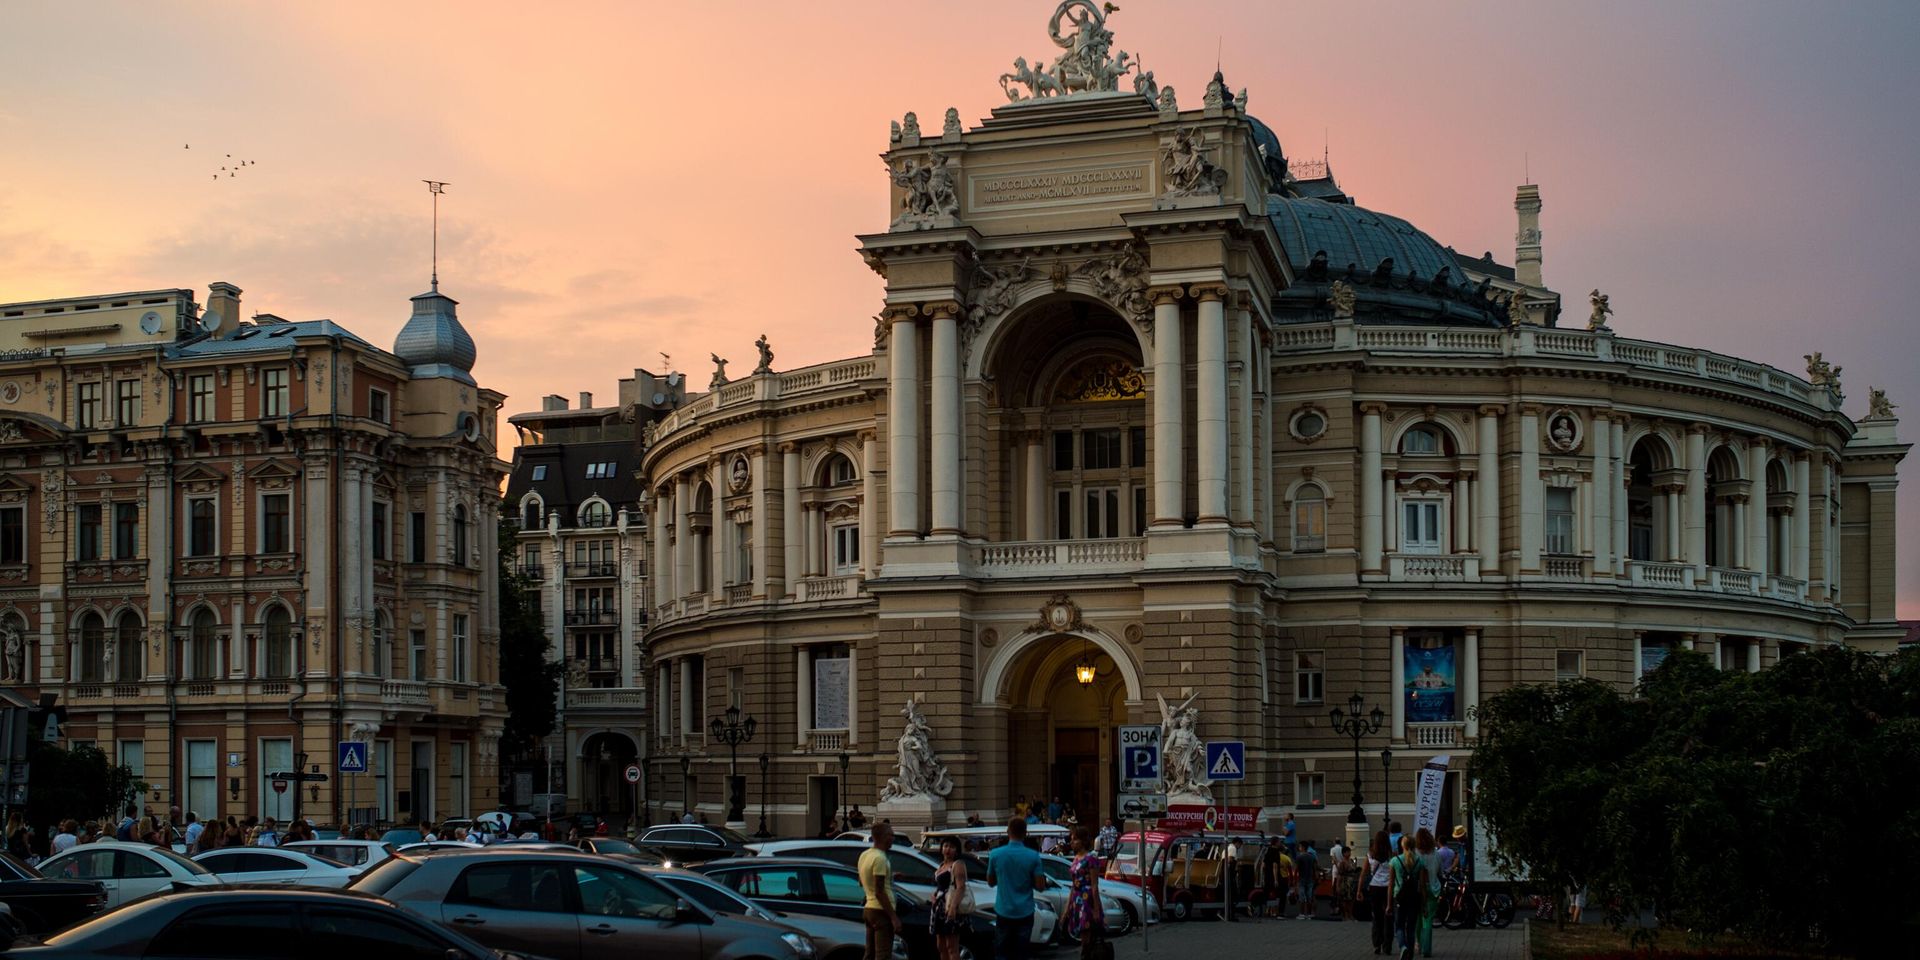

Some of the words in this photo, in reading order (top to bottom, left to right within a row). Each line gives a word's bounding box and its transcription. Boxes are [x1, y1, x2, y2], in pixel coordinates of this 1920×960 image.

[1123, 731, 1158, 742] ЗОНА
[1419, 773, 1434, 826] СКУРСИИ
[1218, 813, 1232, 821] CIY
[1233, 813, 1253, 821] TOURS
